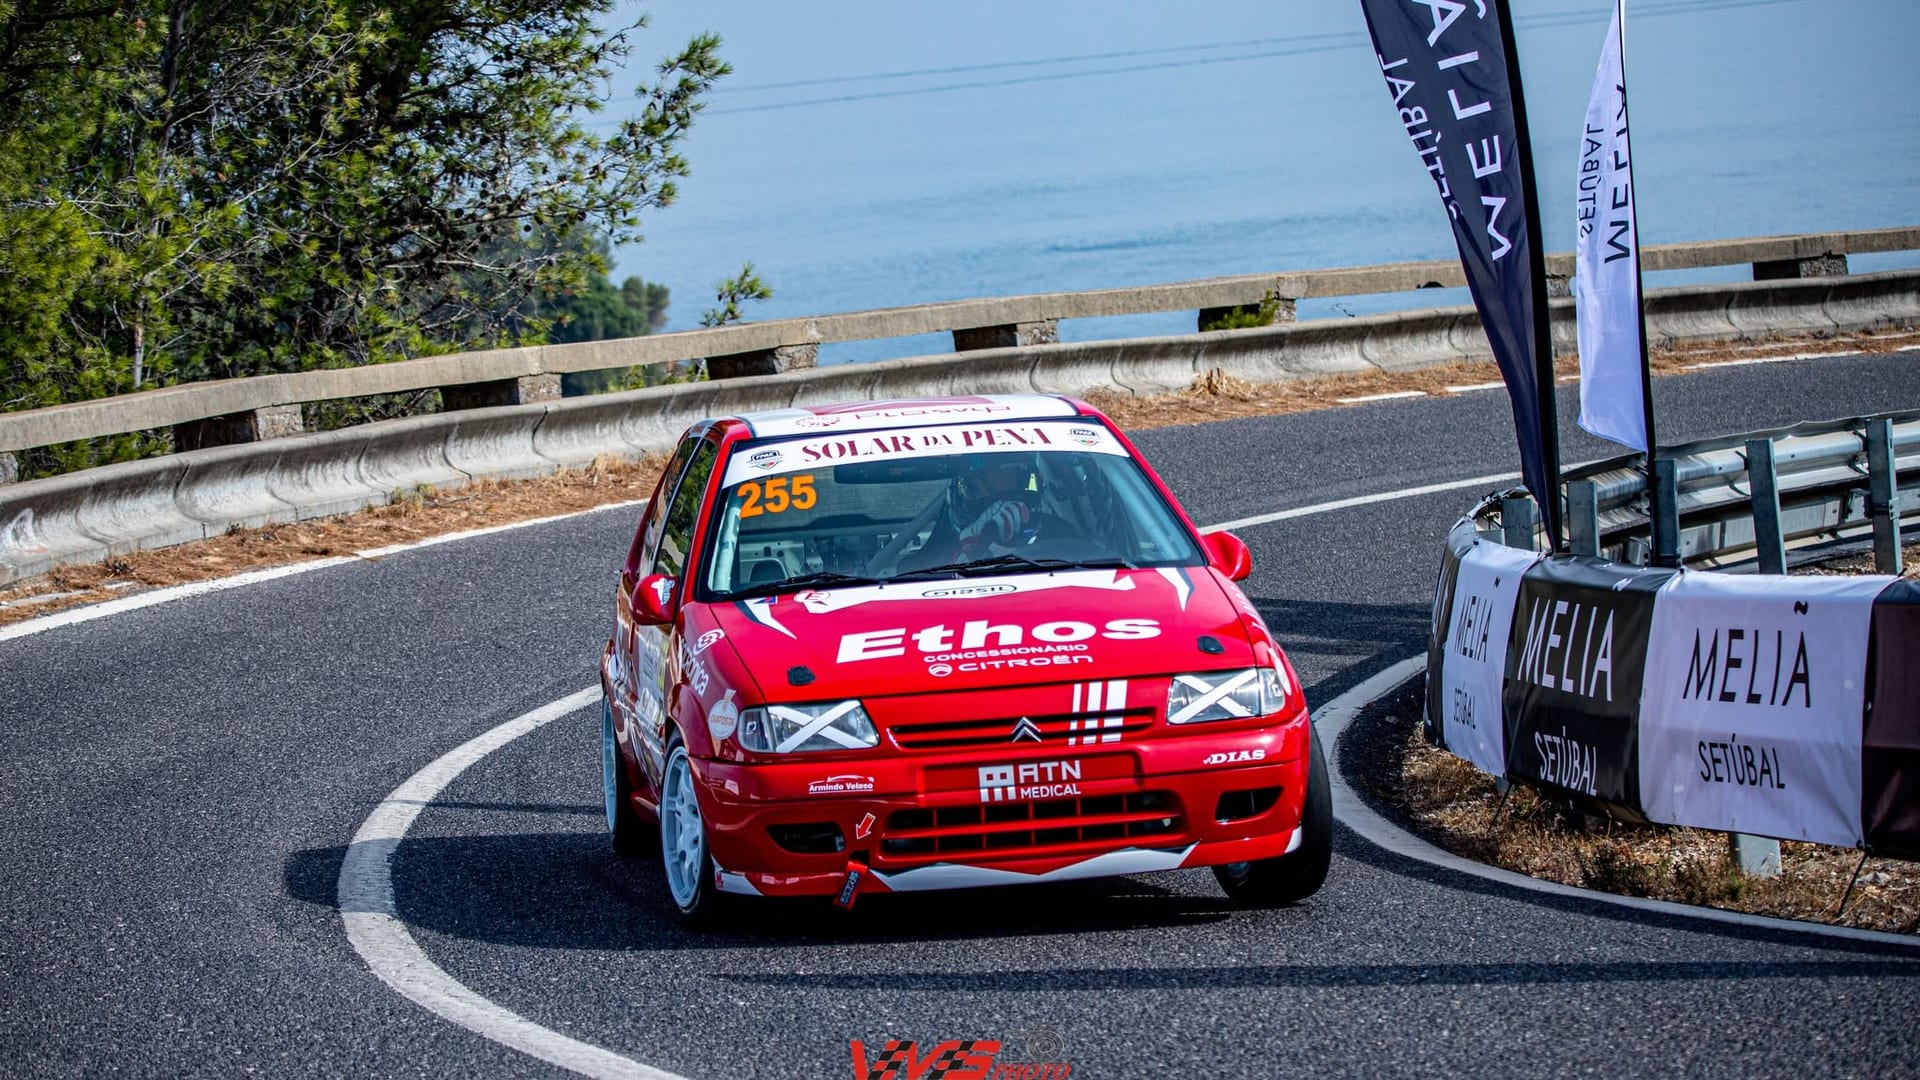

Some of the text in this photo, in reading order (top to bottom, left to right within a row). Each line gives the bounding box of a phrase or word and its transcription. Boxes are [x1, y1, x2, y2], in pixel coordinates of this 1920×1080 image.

[802, 428, 1052, 463] SOLAR DA PENA
[736, 474, 818, 519] 255
[836, 618, 1162, 664] Ethos
[1018, 760, 1082, 784] ATN
[1534, 725, 1598, 797] SETÚBAL
[1699, 733, 1785, 789] SETÚBAL
[809, 782, 874, 792] Armindo Veloso
[1020, 783, 1082, 800] MEDICAL
